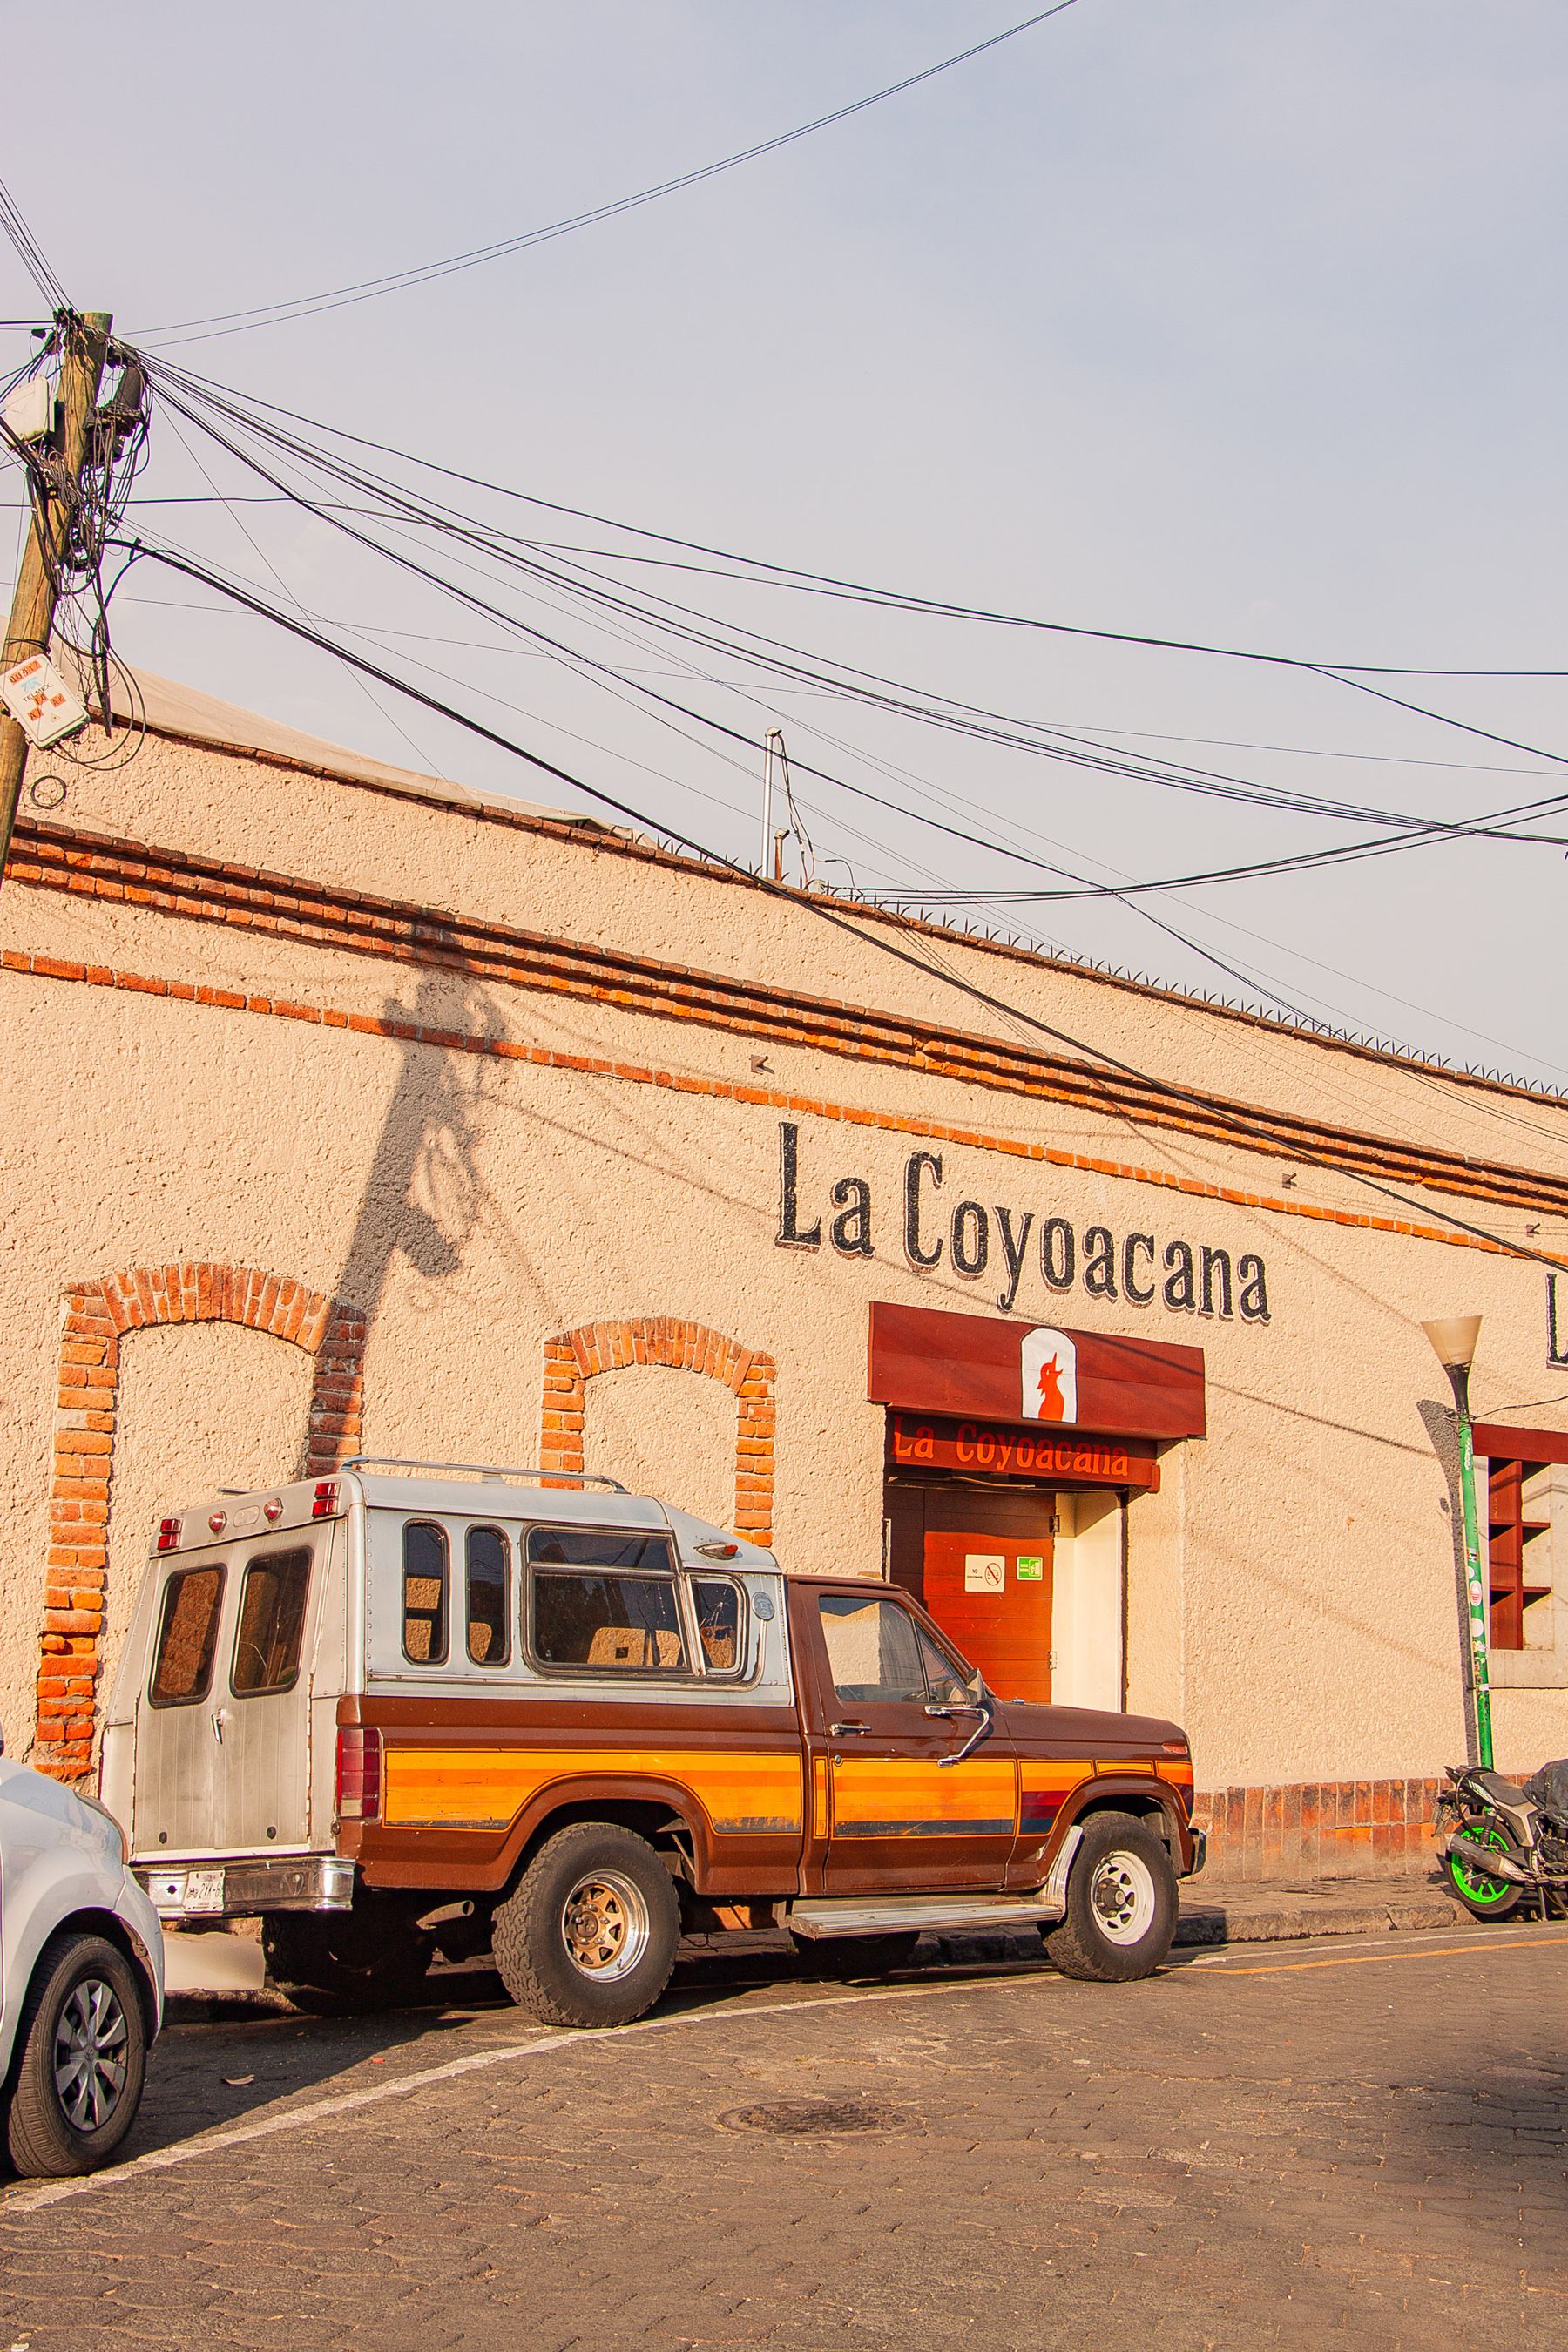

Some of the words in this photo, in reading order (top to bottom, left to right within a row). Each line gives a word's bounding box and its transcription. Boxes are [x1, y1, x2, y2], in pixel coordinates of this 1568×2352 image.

[774, 1121, 875, 1260] La
[903, 1151, 1272, 1325] Coyoacana
[894, 1416, 934, 1459] La
[956, 1423, 1129, 1477] Coyoacana
